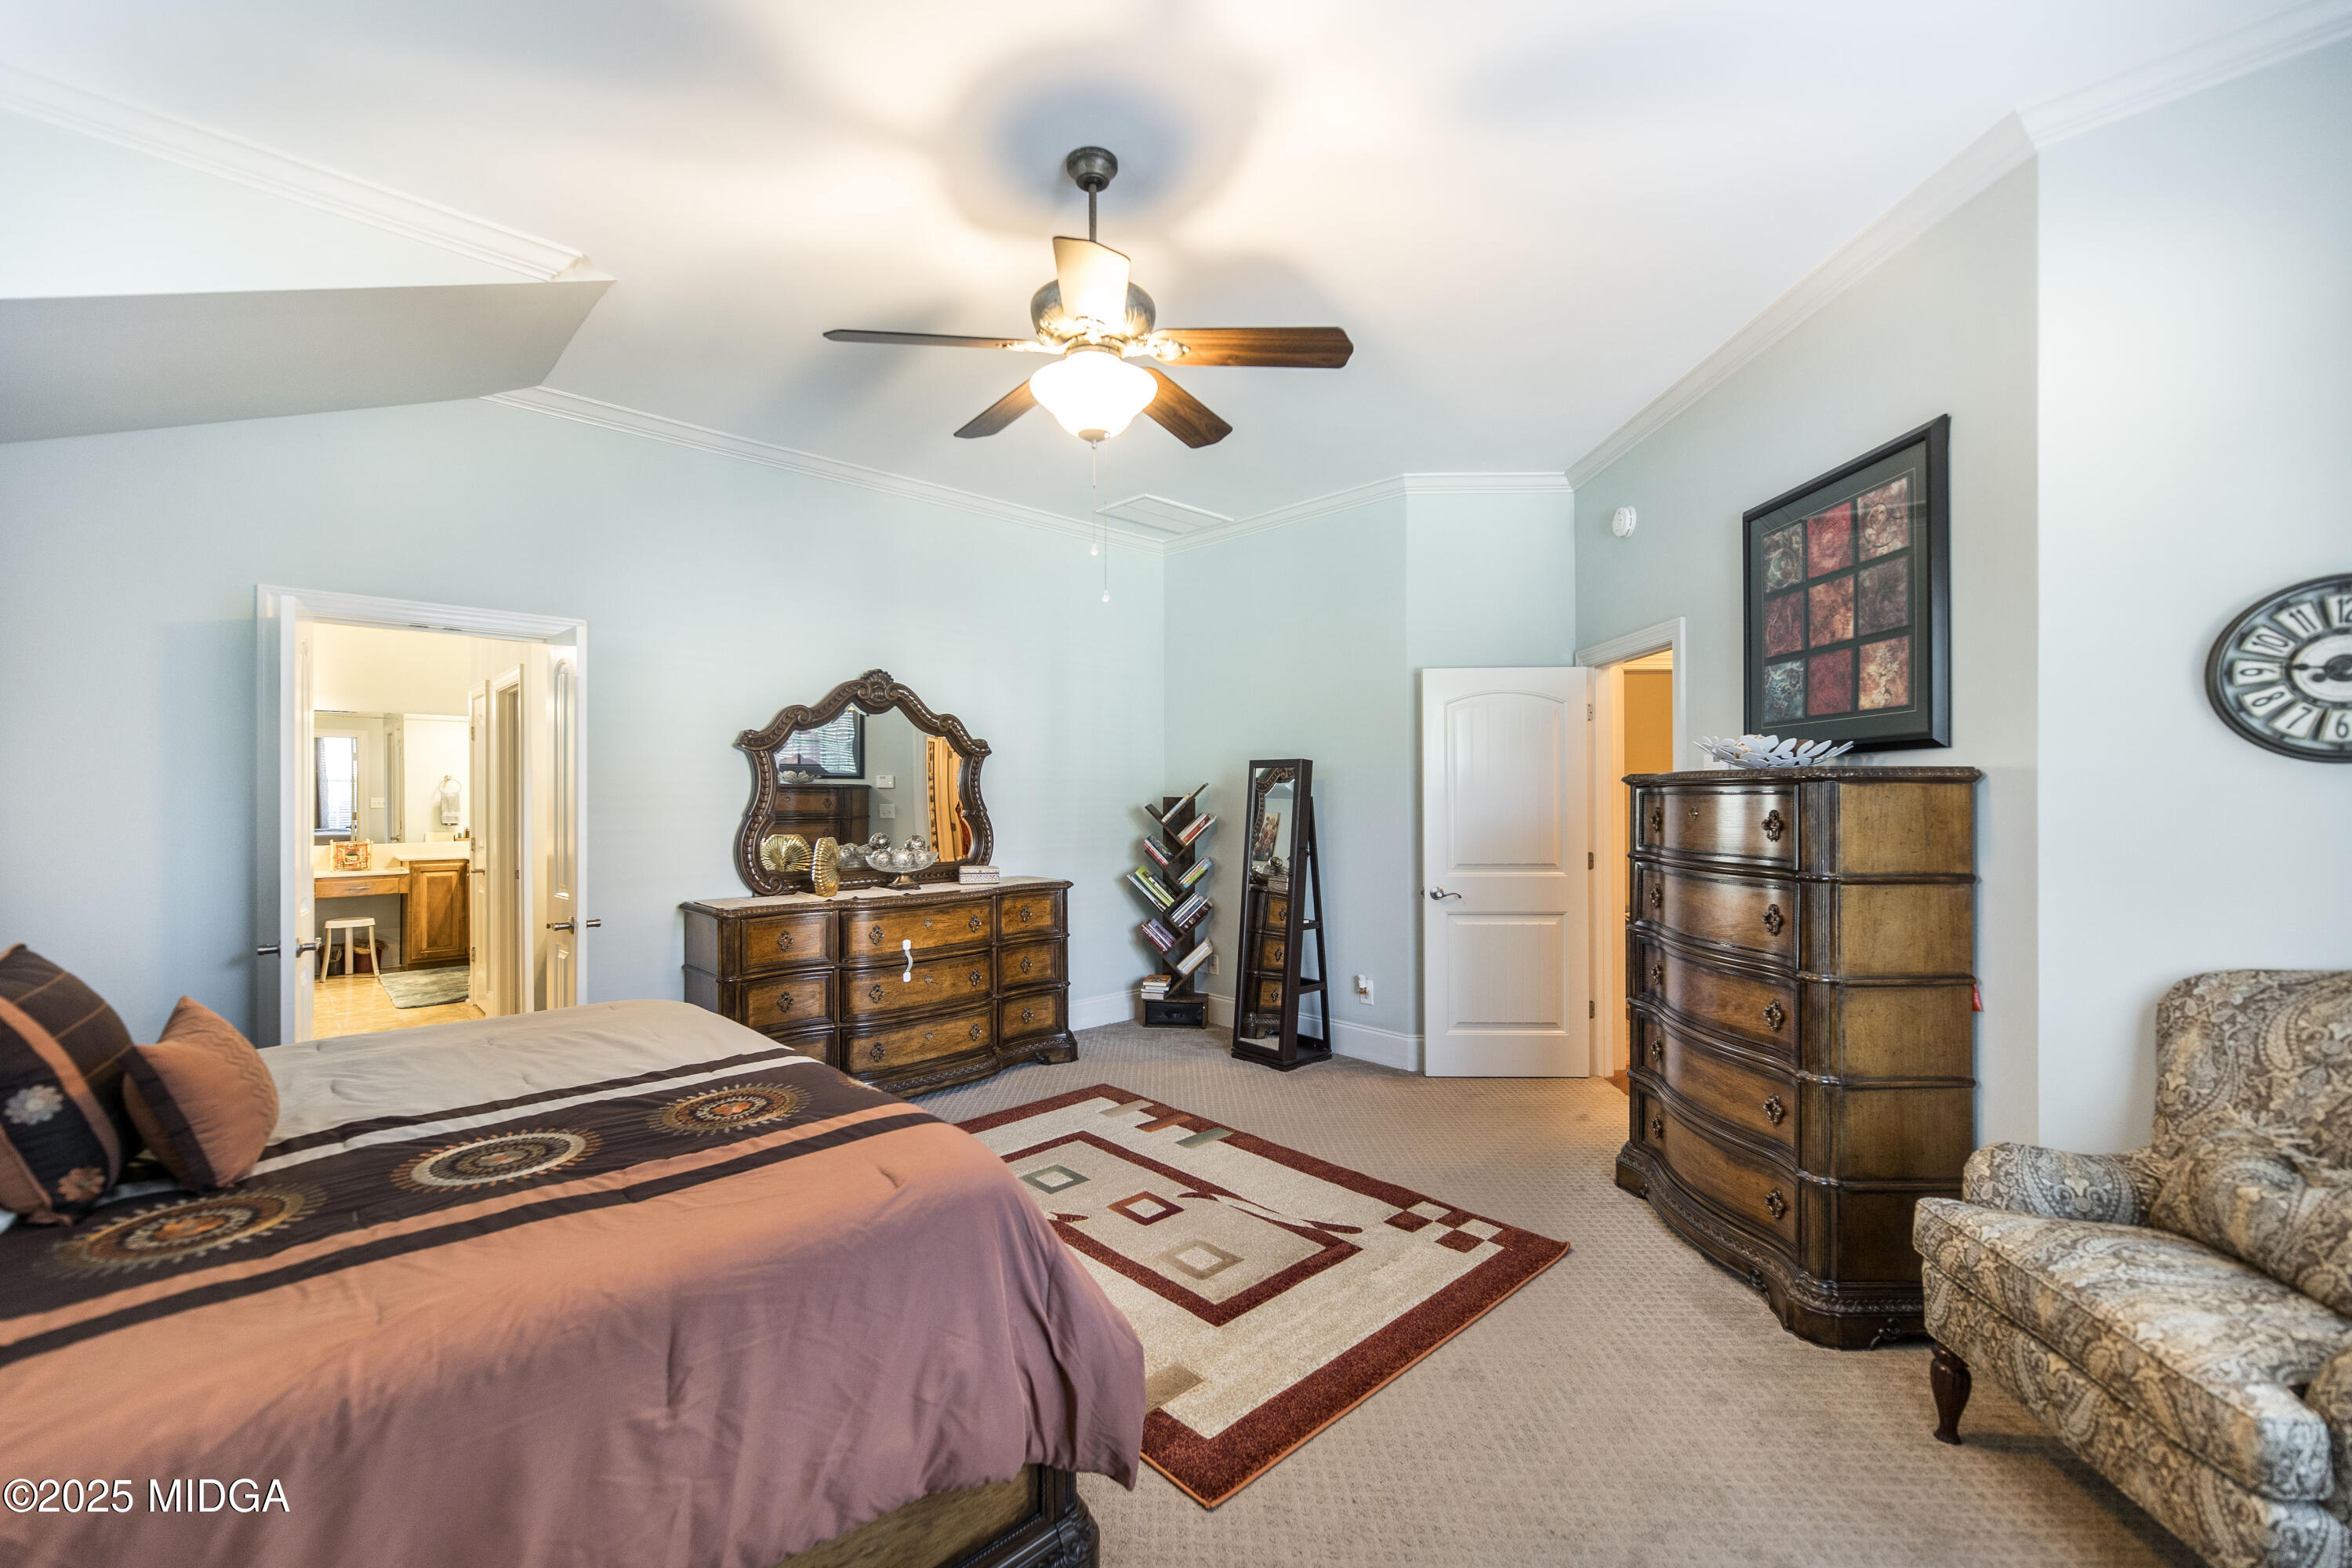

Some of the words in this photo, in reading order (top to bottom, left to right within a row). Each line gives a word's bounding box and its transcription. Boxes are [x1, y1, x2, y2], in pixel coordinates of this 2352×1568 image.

[2288, 609, 2318, 633] 11
[2252, 633, 2288, 653] 10
[2239, 667, 2277, 677] 9
[2252, 691, 2285, 707] 8
[2287, 706, 2312, 730] 7
[2336, 713, 2349, 739] 6
